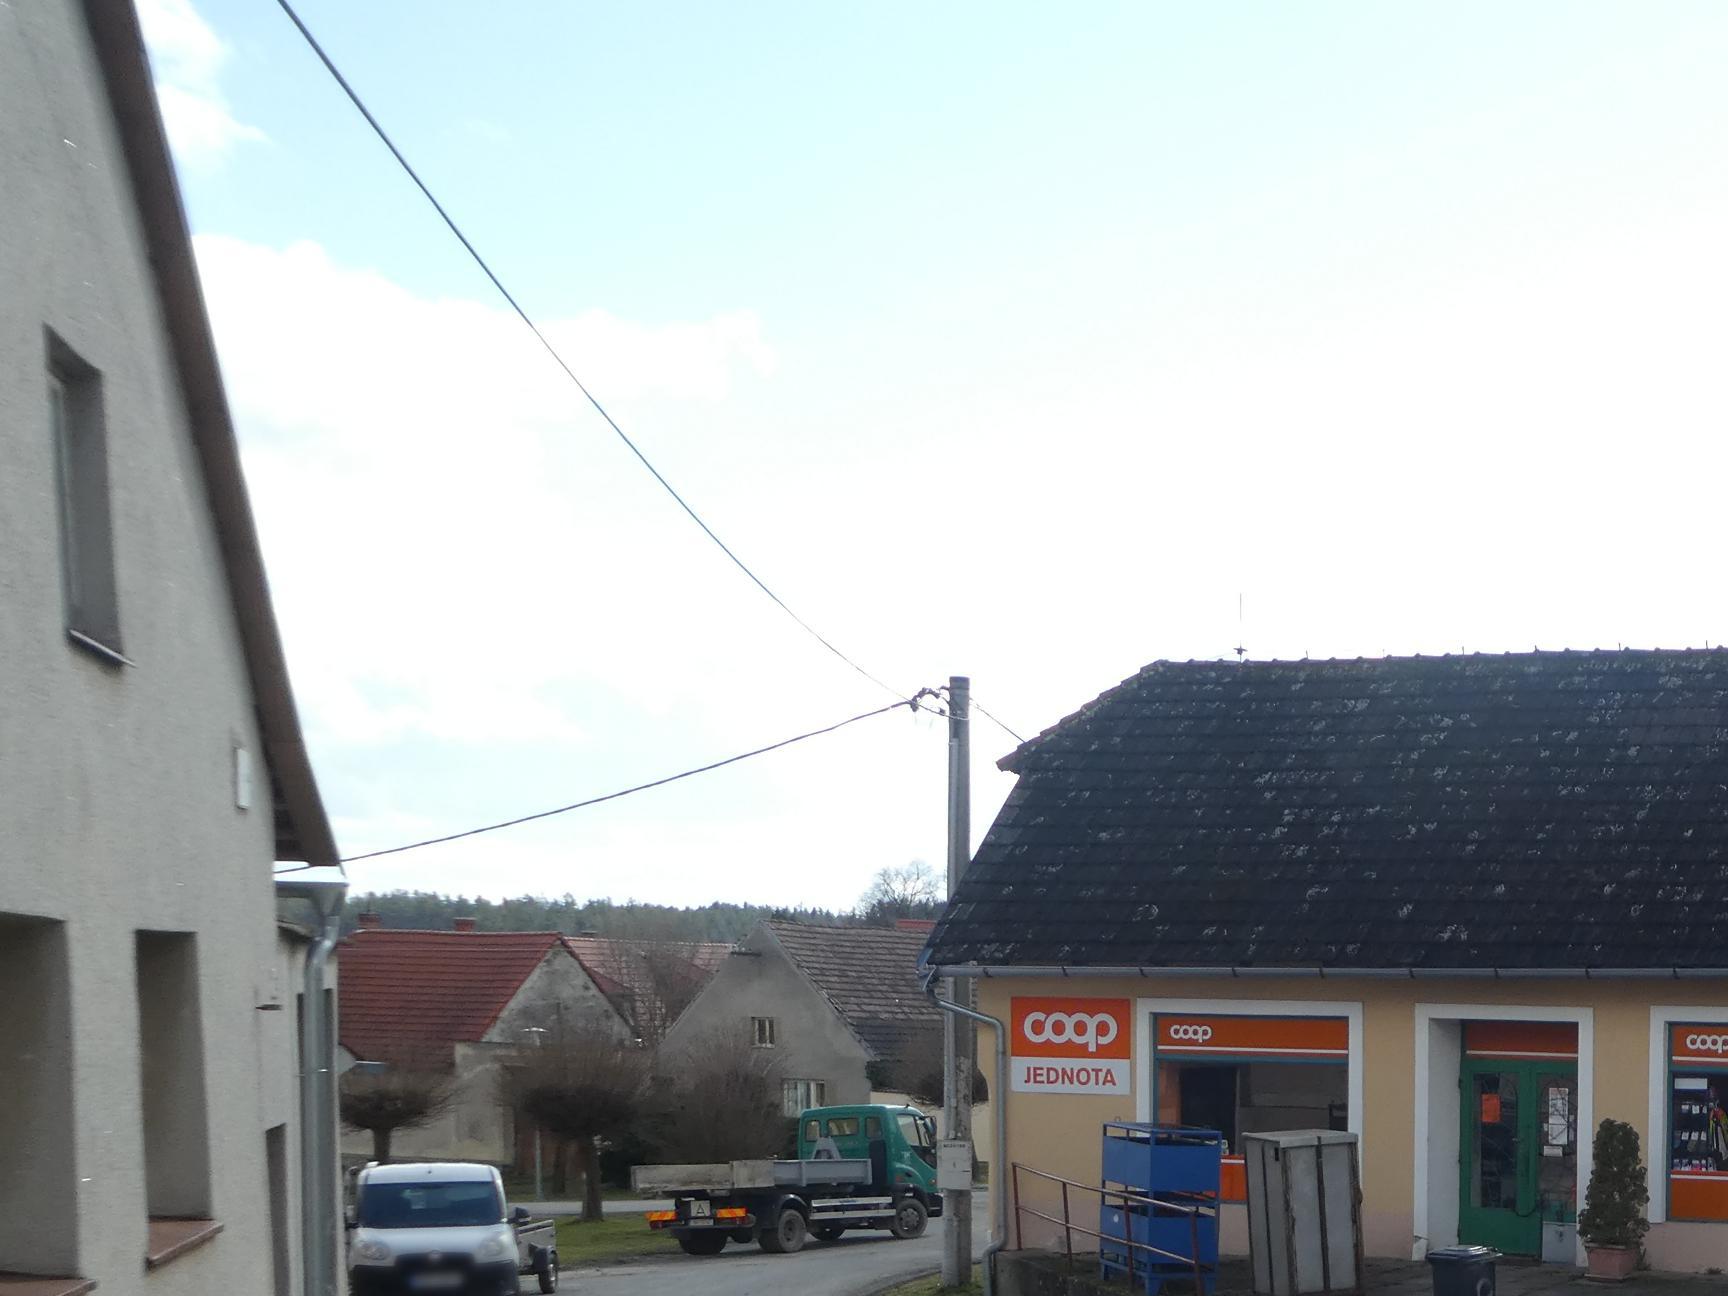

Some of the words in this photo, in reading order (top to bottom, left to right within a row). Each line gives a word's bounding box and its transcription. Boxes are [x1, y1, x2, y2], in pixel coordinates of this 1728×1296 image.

[1023, 1012, 1118, 1052] coop
[1170, 1024, 1212, 1043] coop
[1024, 1066, 1117, 1087] JEDNOTA
